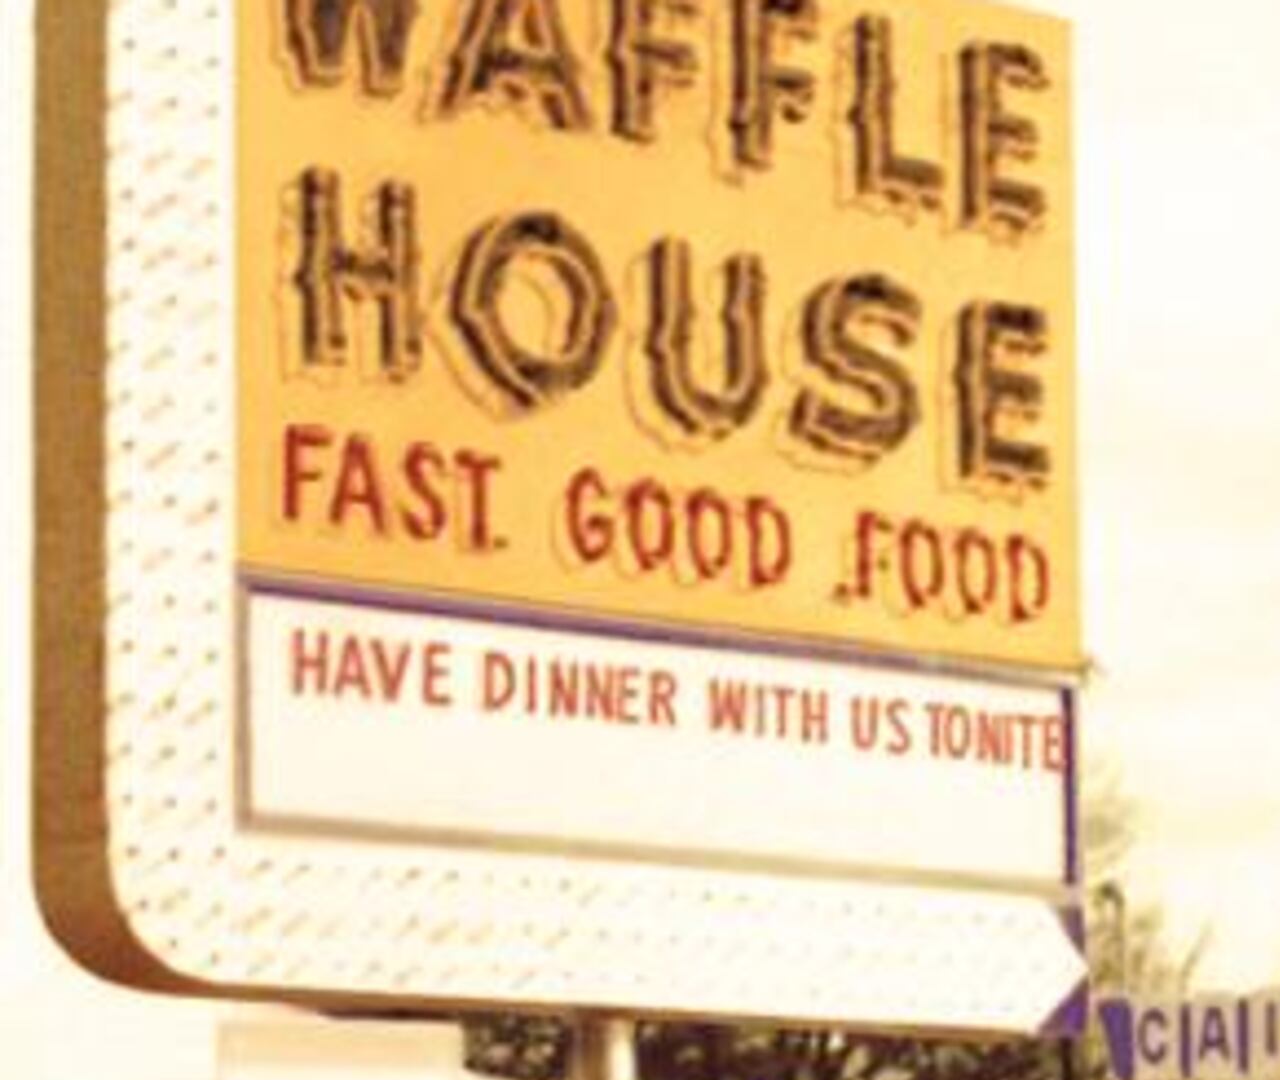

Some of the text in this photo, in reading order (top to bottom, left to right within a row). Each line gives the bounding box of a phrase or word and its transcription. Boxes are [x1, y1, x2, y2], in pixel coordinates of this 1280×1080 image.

[288, 166, 1050, 482] HOUSE
[565, 468, 792, 587] GOOD
[290, 630, 1066, 772] HAVE DINNER WITH US TONITE
